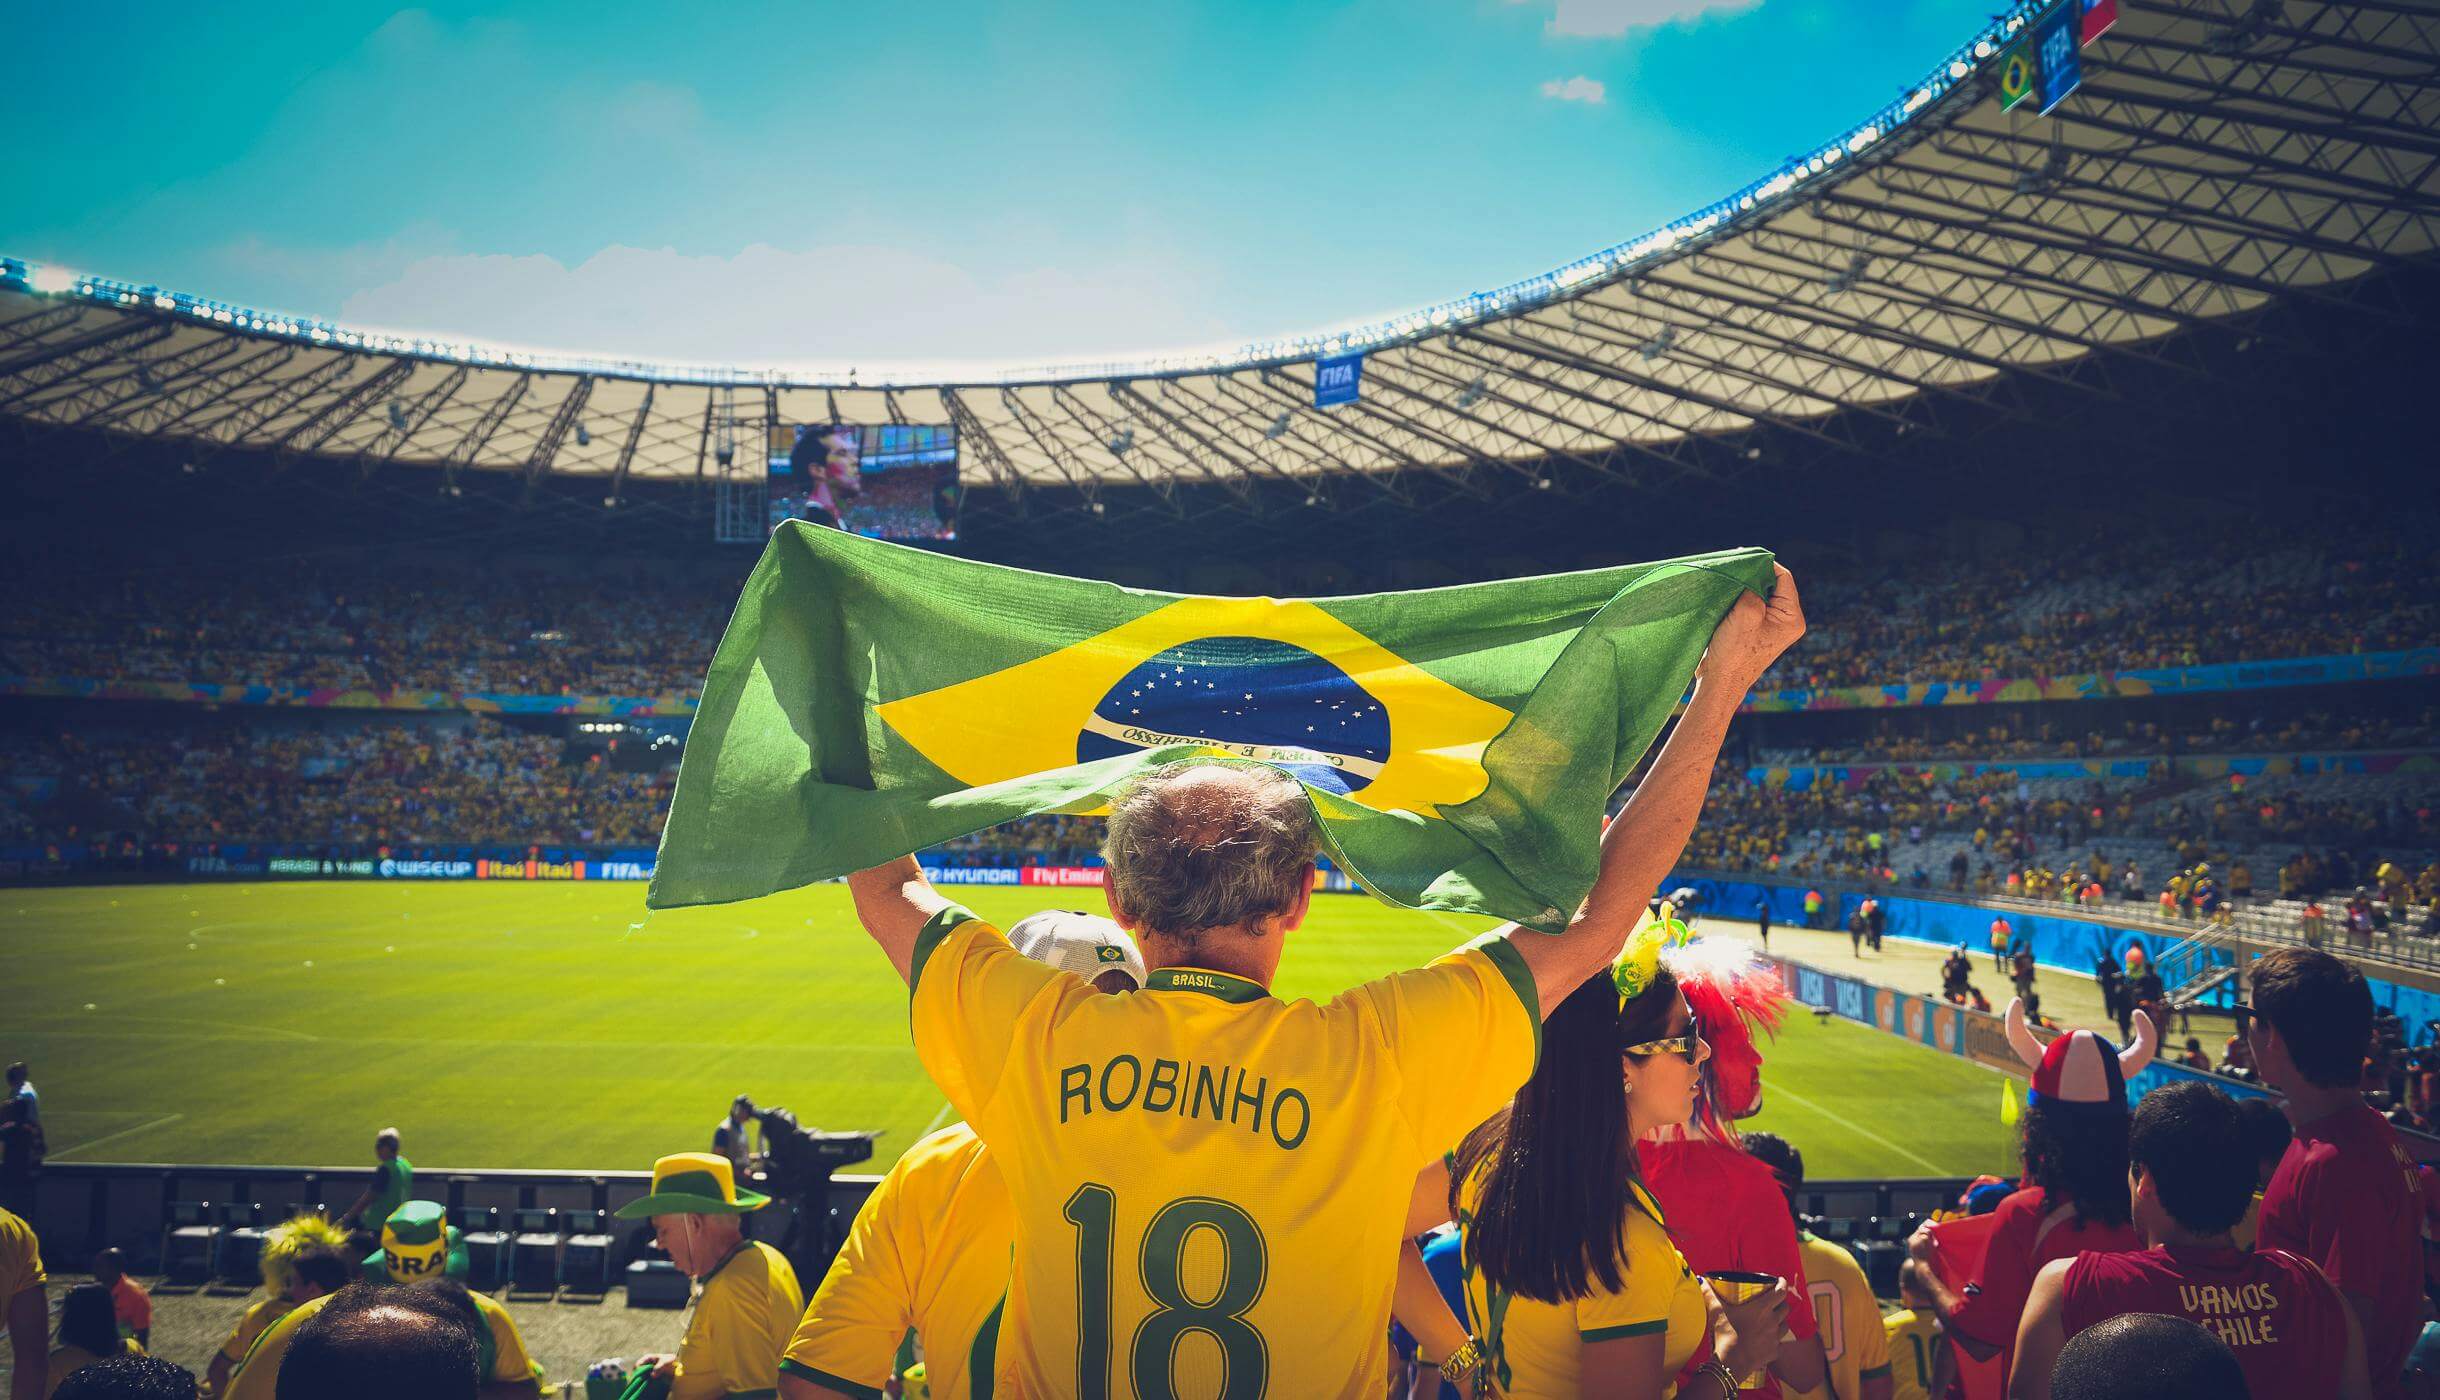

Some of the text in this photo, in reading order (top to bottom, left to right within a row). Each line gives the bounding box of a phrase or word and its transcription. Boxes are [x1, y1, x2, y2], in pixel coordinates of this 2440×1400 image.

[1320, 364, 1353, 387] FIFA
[1241, 745, 1256, 757] E
[489, 860, 573, 878] Itaú Itaú
[602, 862, 652, 879] FIFA.
[943, 868, 1018, 883] HYUNDAI
[1033, 867, 1058, 886] Fly
[1172, 974, 1216, 988] BRASIL
[1799, 968, 1863, 1019] VISA VISA
[1060, 1054, 1311, 1150] ROBINHO
[1063, 1181, 1270, 1400] 18
[2178, 1282, 2280, 1314] VAMOS
